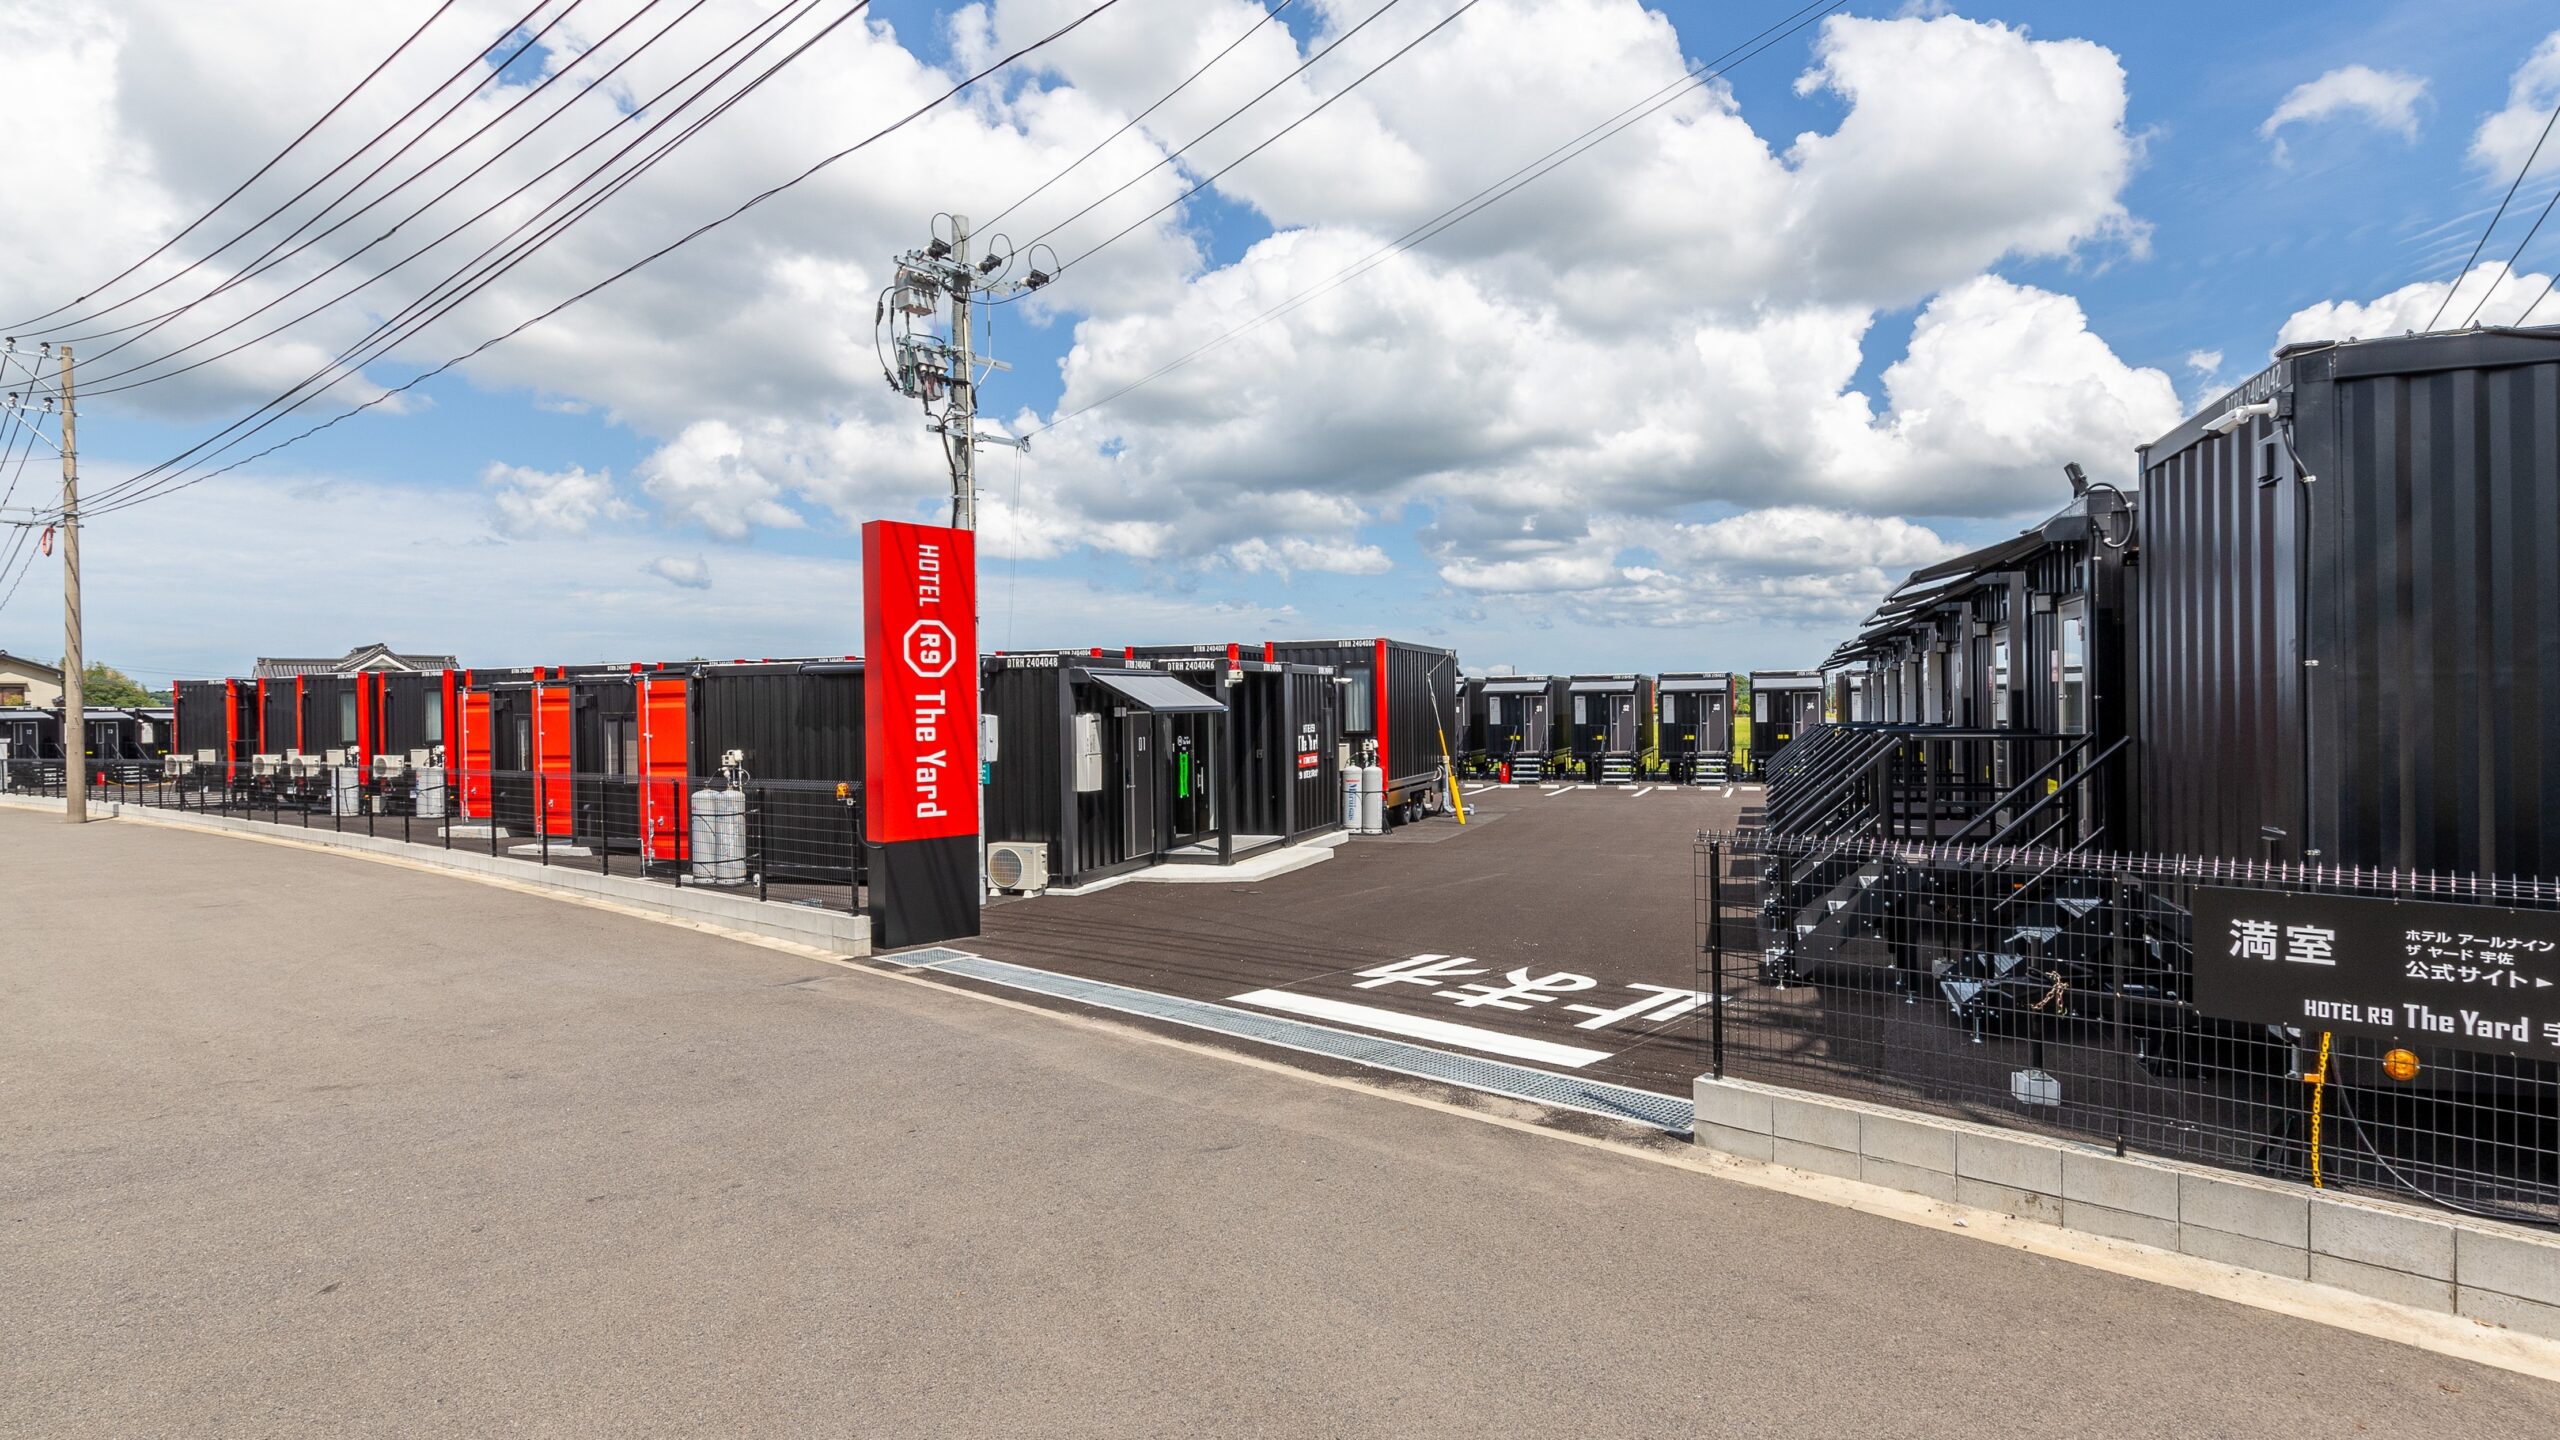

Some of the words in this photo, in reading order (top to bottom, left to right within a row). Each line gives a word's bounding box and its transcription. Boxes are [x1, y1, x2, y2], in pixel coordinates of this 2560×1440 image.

[2245, 364, 2281, 406] 2404042
[919, 544, 939, 606] HOTEL
[920, 633, 940, 664] R9
[1007, 658, 1025, 668] DTRH
[1026, 657, 1058, 668] 2404048
[1167, 661, 1184, 671] DTRH
[1185, 660, 1215, 671] 2404046
[915, 689, 946, 742] The
[1138, 736, 1146, 751] 01
[916, 749, 947, 818] Yard
[2229, 918, 2336, 966] 満室
[2405, 929, 2452, 944] ホテル
[2458, 933, 2556, 952] アールナイン
[2405, 944, 2422, 956] ザ
[2427, 946, 2474, 961] ヤード
[2480, 951, 2515, 966] 宇佐
[1351, 953, 1734, 1031] 止まれ
[2405, 960, 2529, 989] 公式サイト
[2304, 999, 2363, 1023] HOTEL
[2367, 1006, 2394, 1026] R9
[2403, 1003, 2455, 1034] The
[2460, 1009, 2529, 1043] Yard
